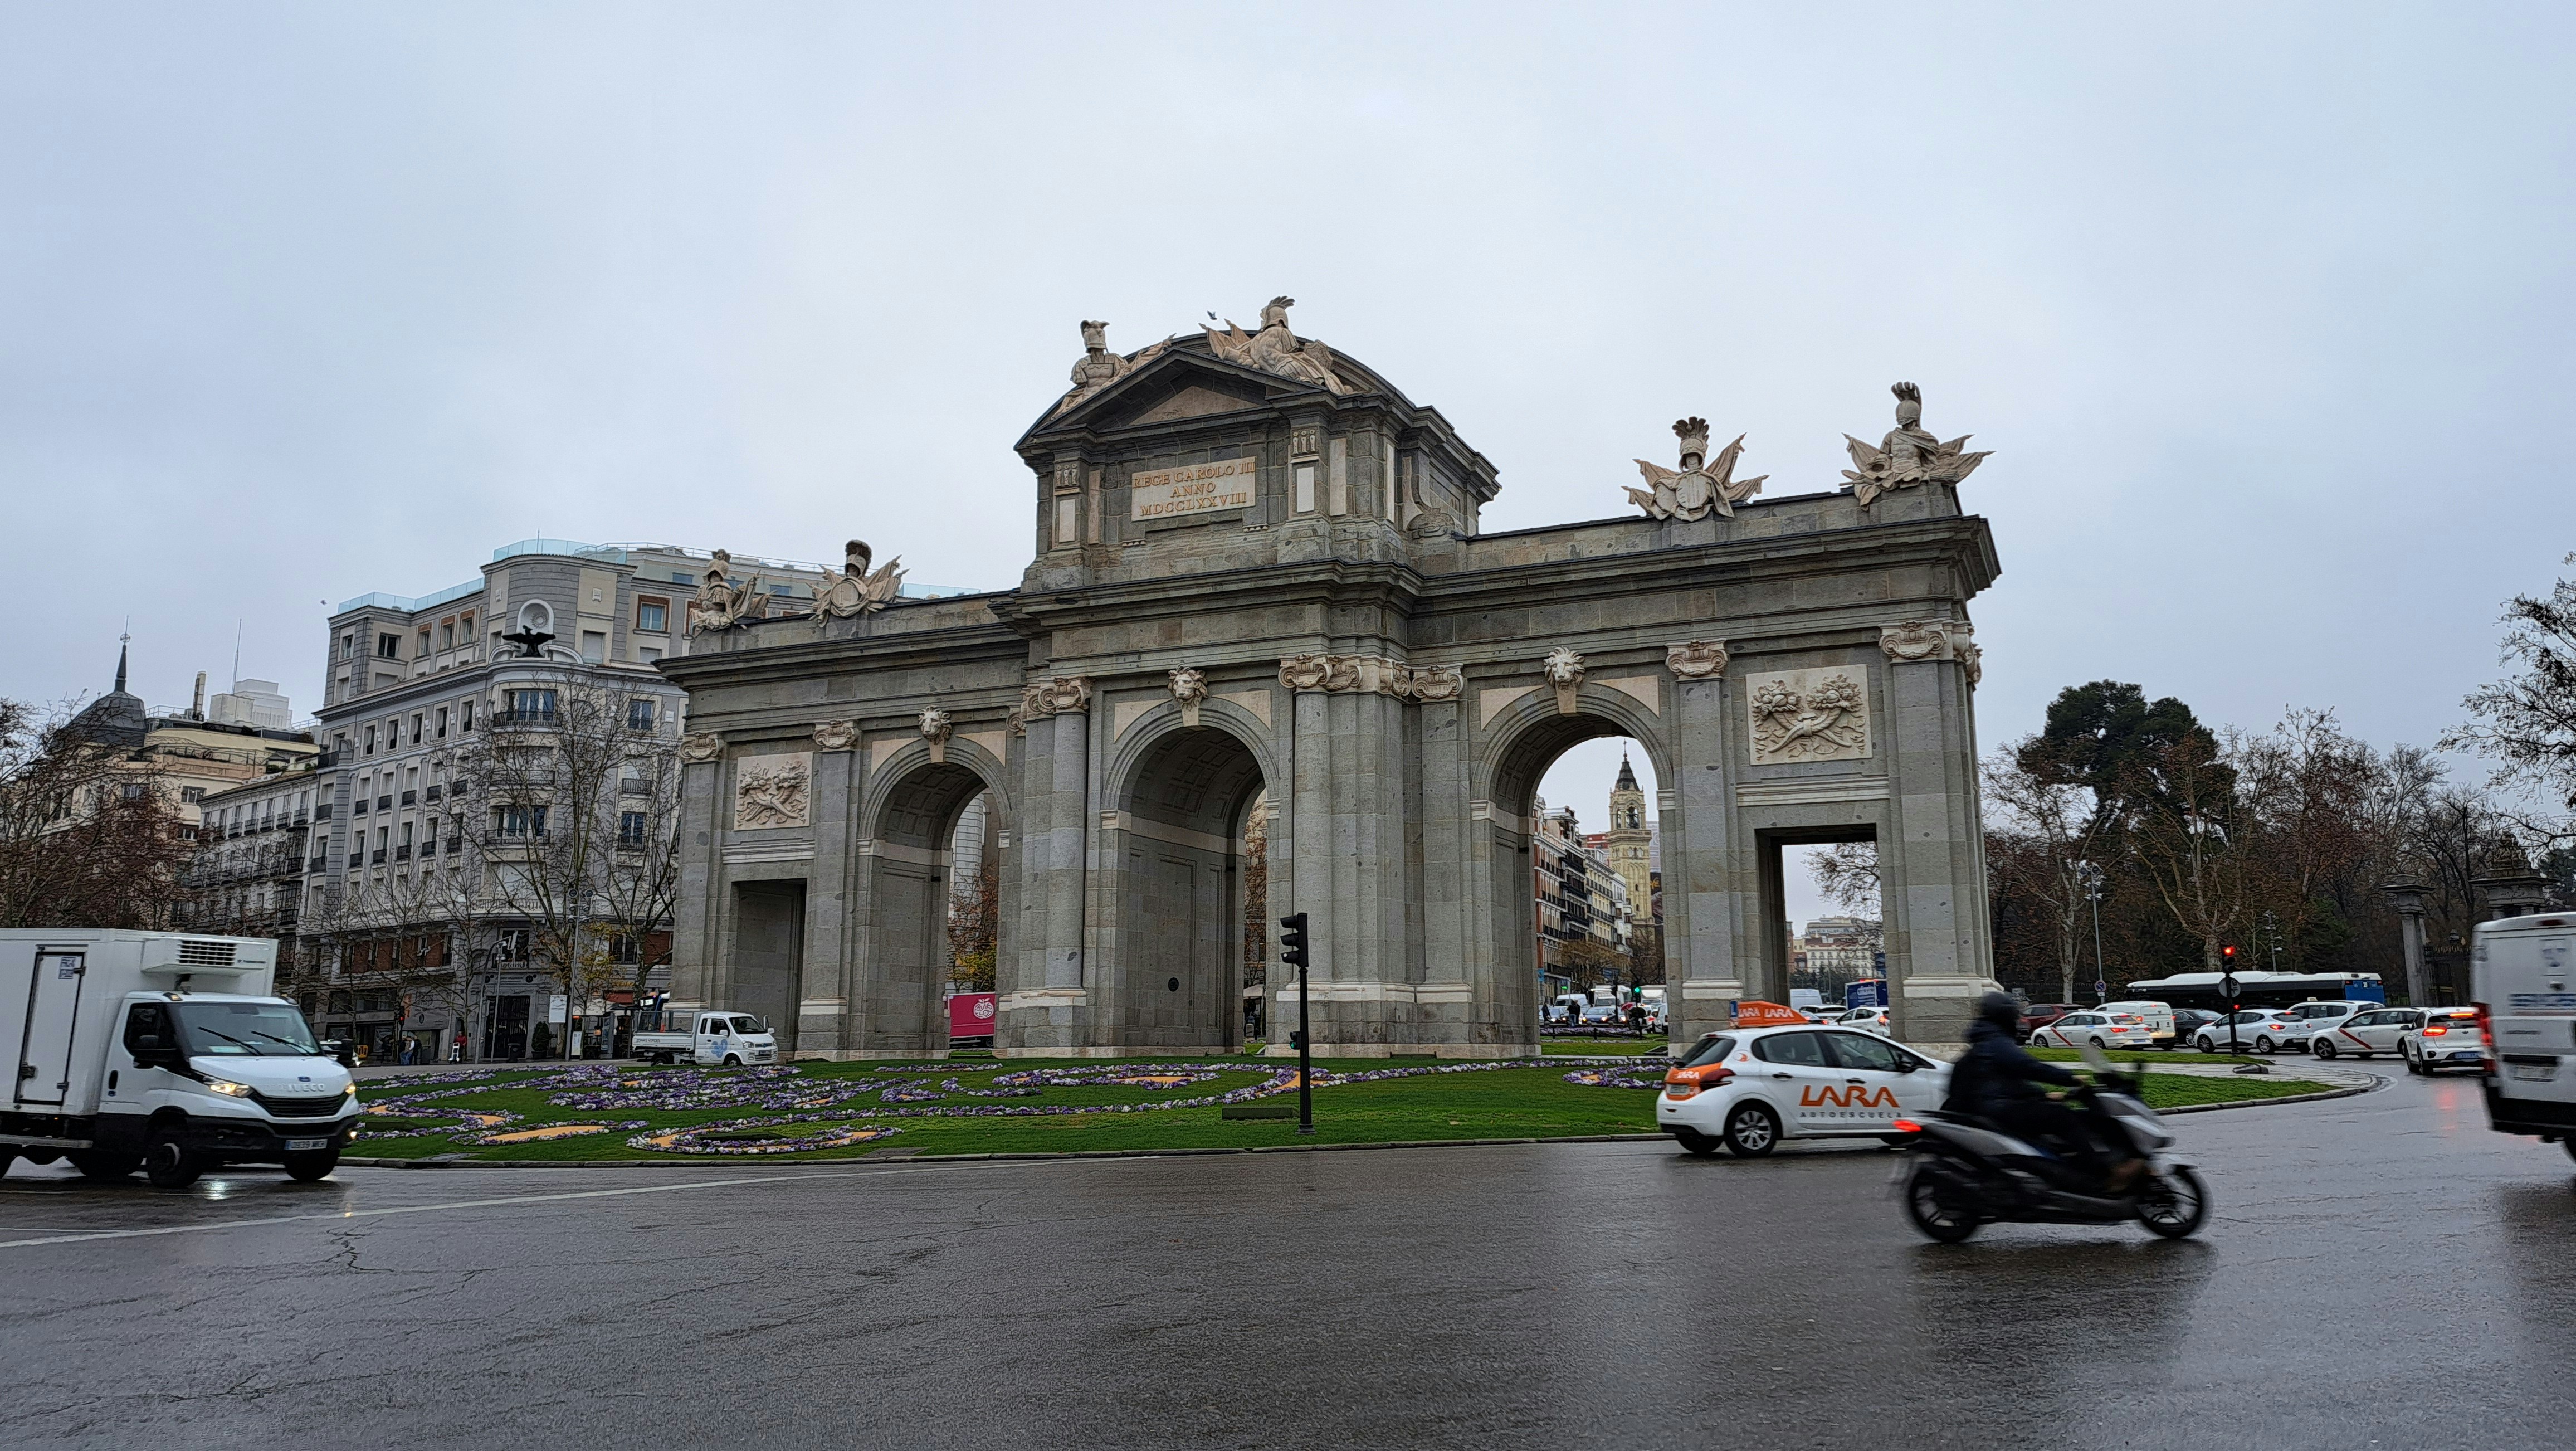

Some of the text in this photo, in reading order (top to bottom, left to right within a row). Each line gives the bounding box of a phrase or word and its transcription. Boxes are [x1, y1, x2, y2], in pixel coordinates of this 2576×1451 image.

[1132, 461, 1256, 489] REGE CAROLO III
[1170, 481, 1216, 498] ANNO
[1139, 491, 1247, 517] MDCCLXXVIII
[1763, 1008, 1794, 1019] LARA
[287, 1083, 325, 1092] IVECO
[1799, 1085, 1901, 1108] LARA
